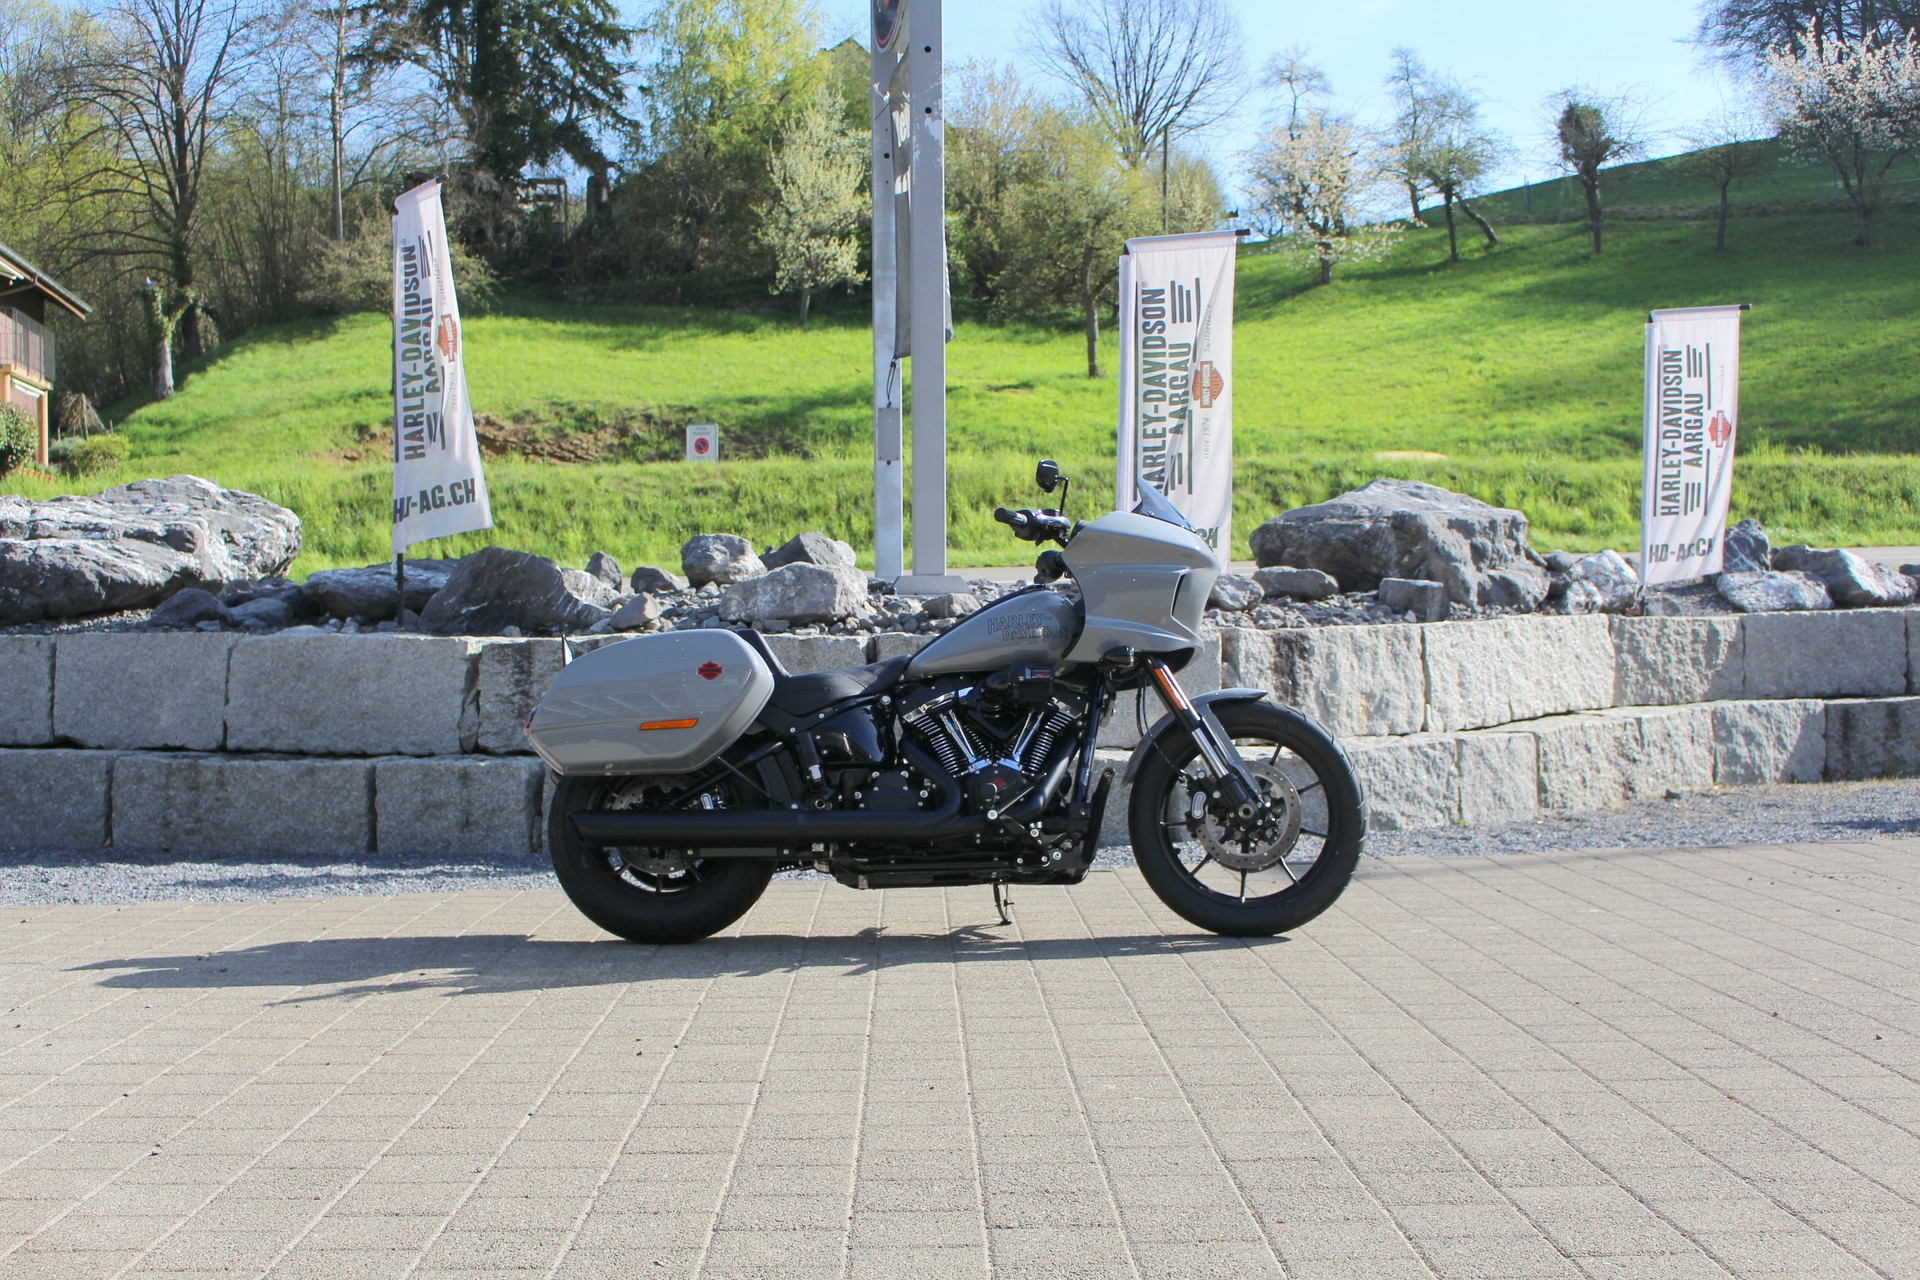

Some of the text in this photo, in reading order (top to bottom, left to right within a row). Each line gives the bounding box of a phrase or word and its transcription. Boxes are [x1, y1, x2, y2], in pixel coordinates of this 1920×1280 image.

[1168, 342, 1191, 436] AARGAU
[1201, 417, 1210, 459] since 1974
[1683, 393, 1703, 468] AARGAU
[1002, 625, 1070, 641] DAVIDSON
